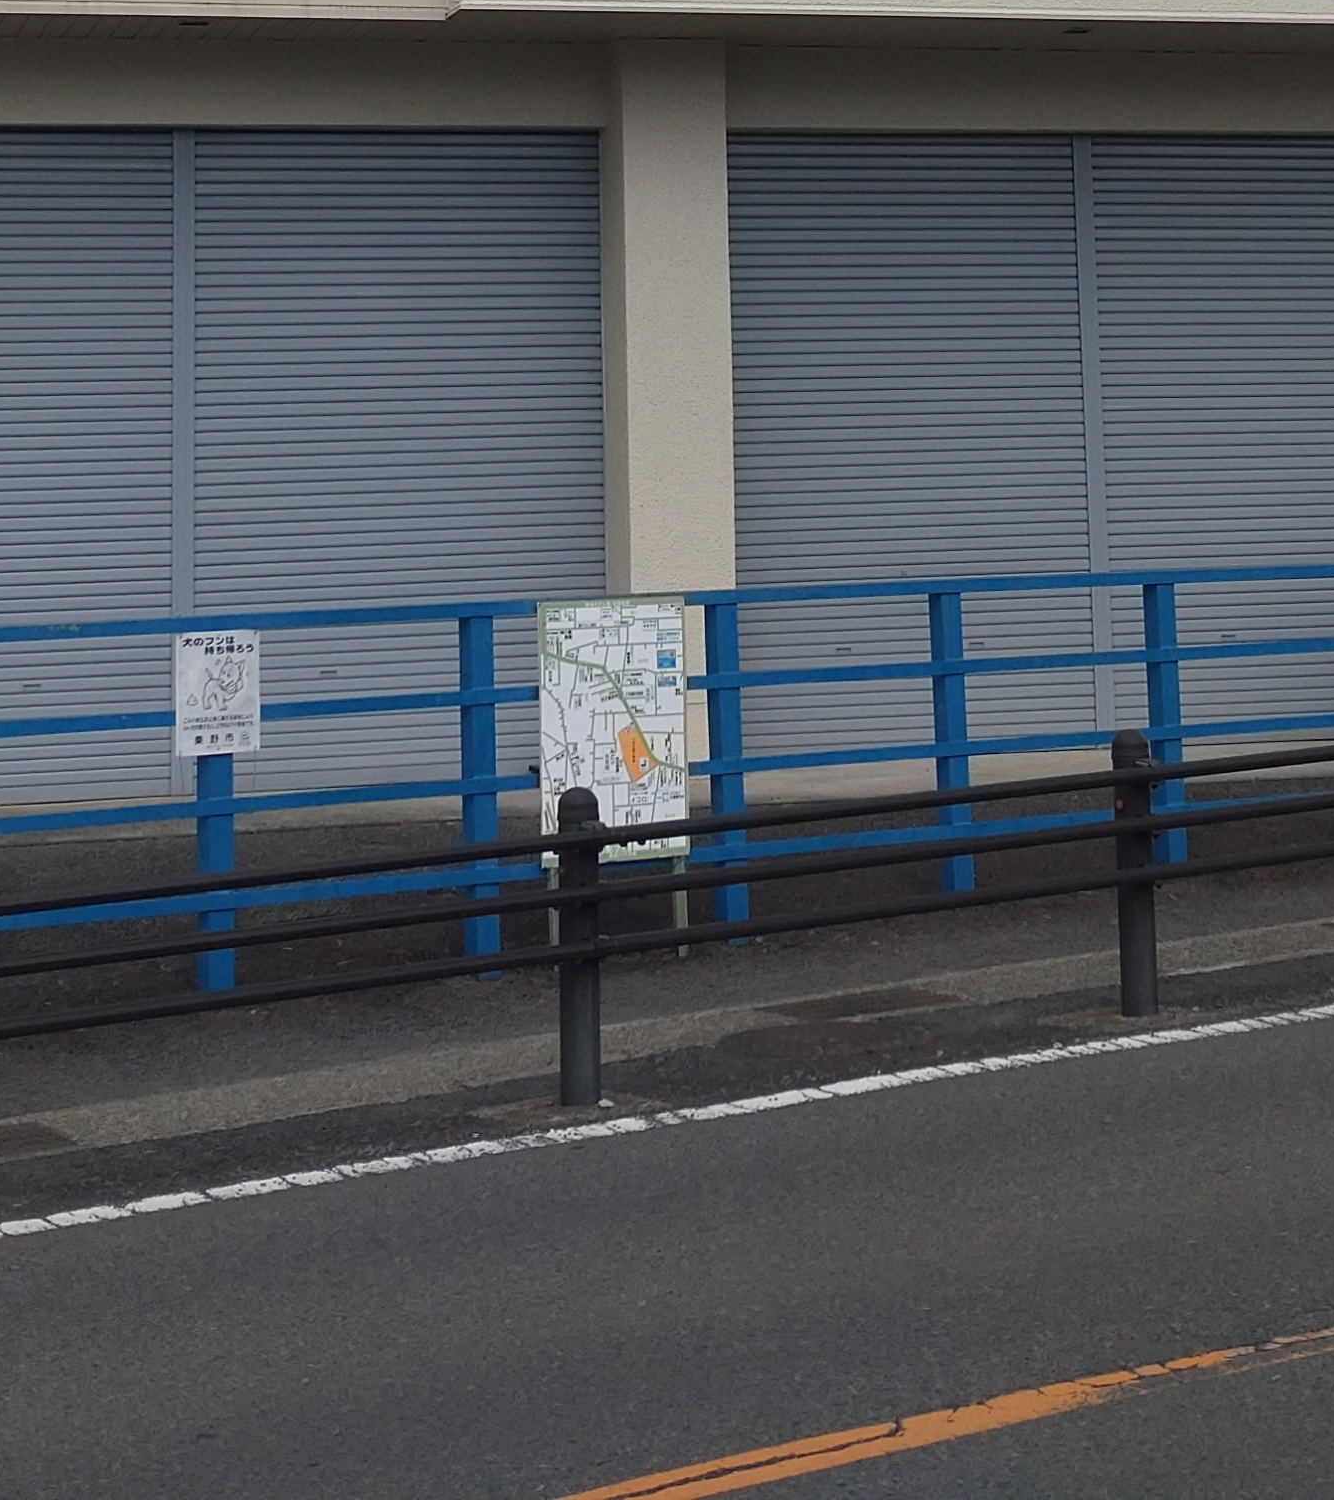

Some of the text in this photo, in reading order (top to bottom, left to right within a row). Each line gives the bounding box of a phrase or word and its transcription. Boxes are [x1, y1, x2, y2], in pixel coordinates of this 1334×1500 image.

[182, 636, 235, 647] 犬のフンは
